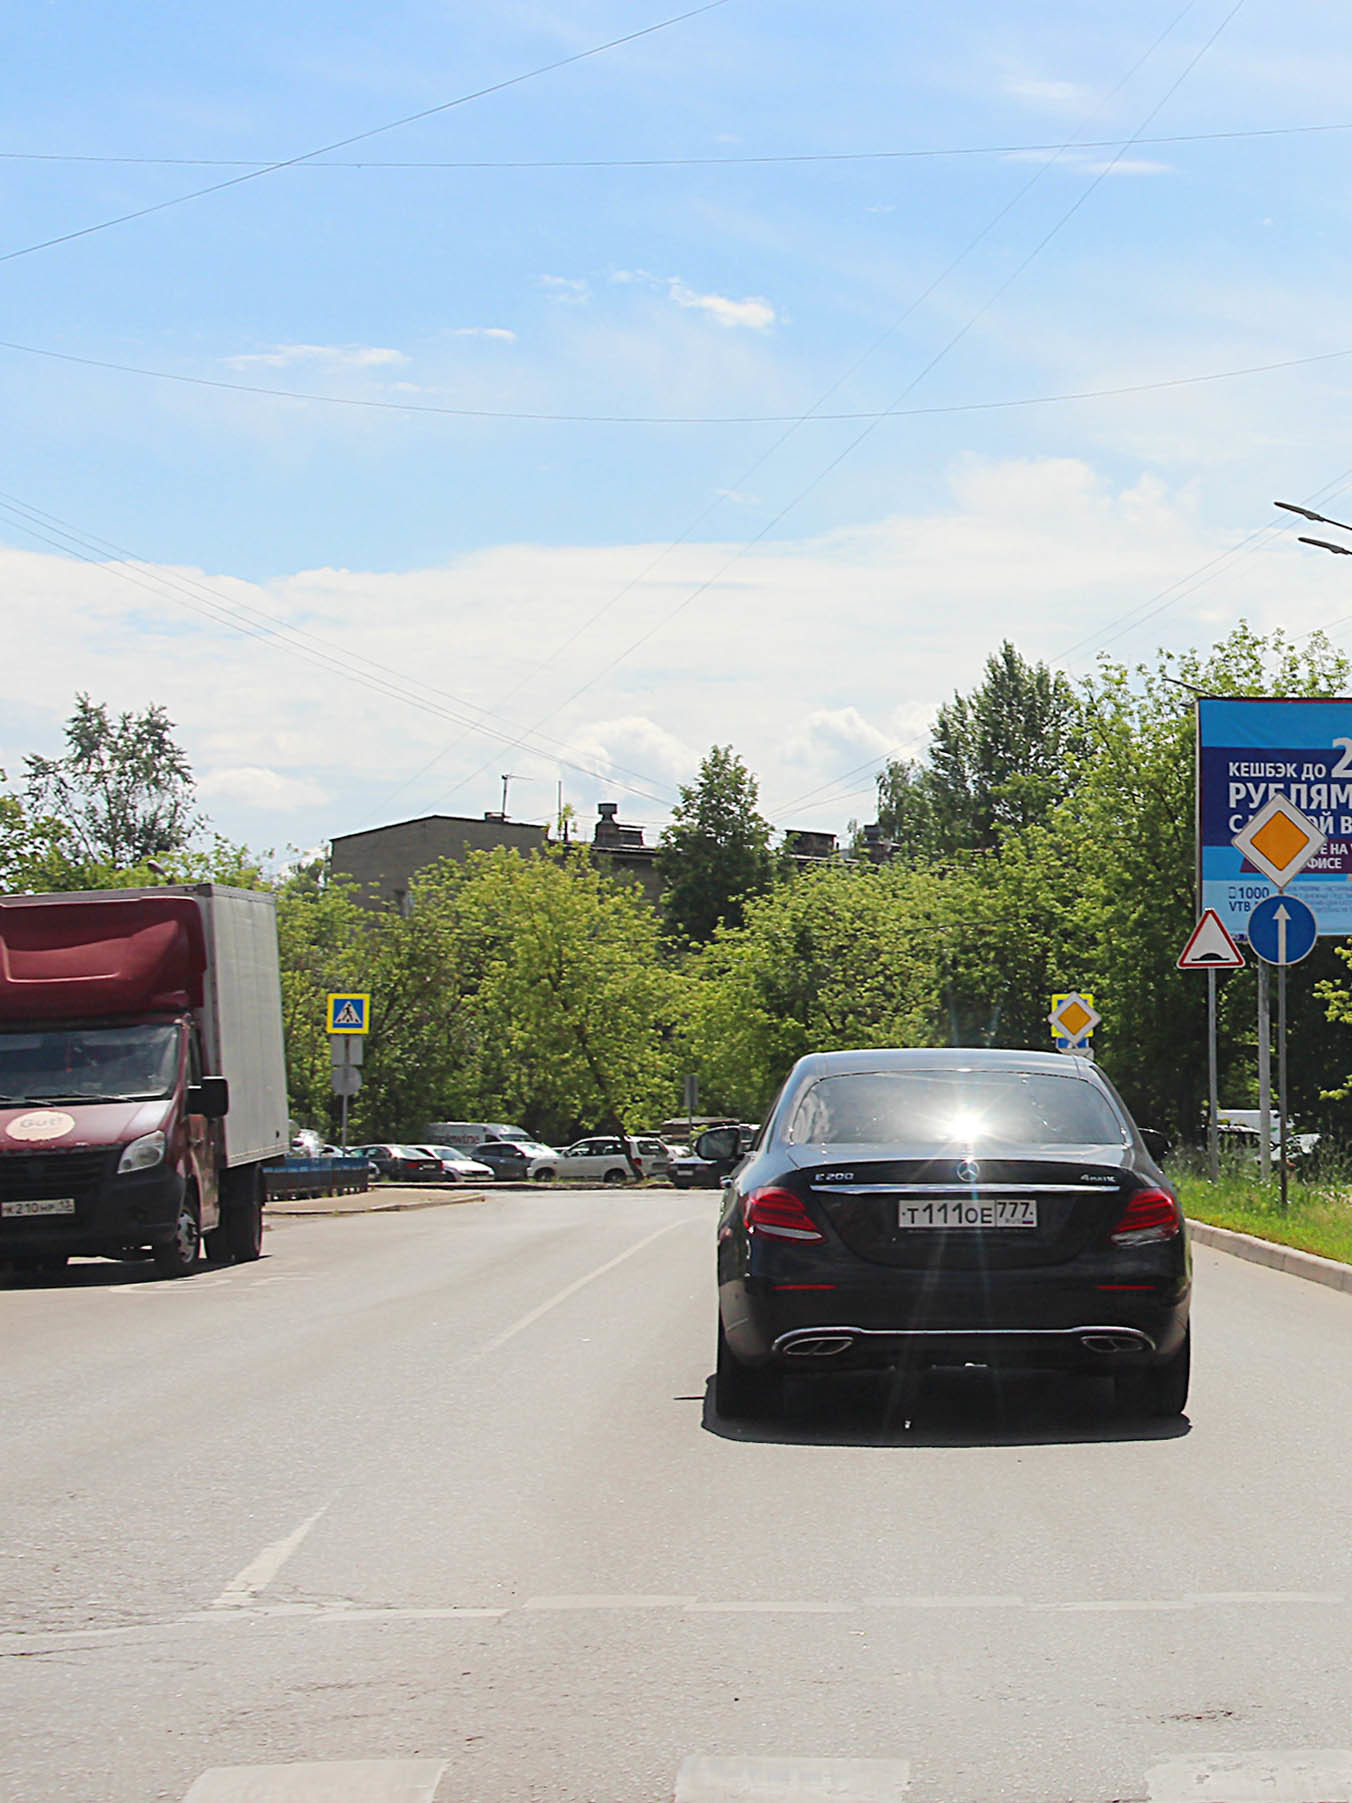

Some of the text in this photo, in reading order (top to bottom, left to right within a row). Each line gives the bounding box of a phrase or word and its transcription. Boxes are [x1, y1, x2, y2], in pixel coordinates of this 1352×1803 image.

[1228, 762, 1297, 778] КЕШБЭК
[1301, 763, 1327, 781] ДО
[1330, 843, 1349, 855] НА
[1305, 857, 1342, 869] ФИСЕ
[1239, 887, 1270, 899] 1000
